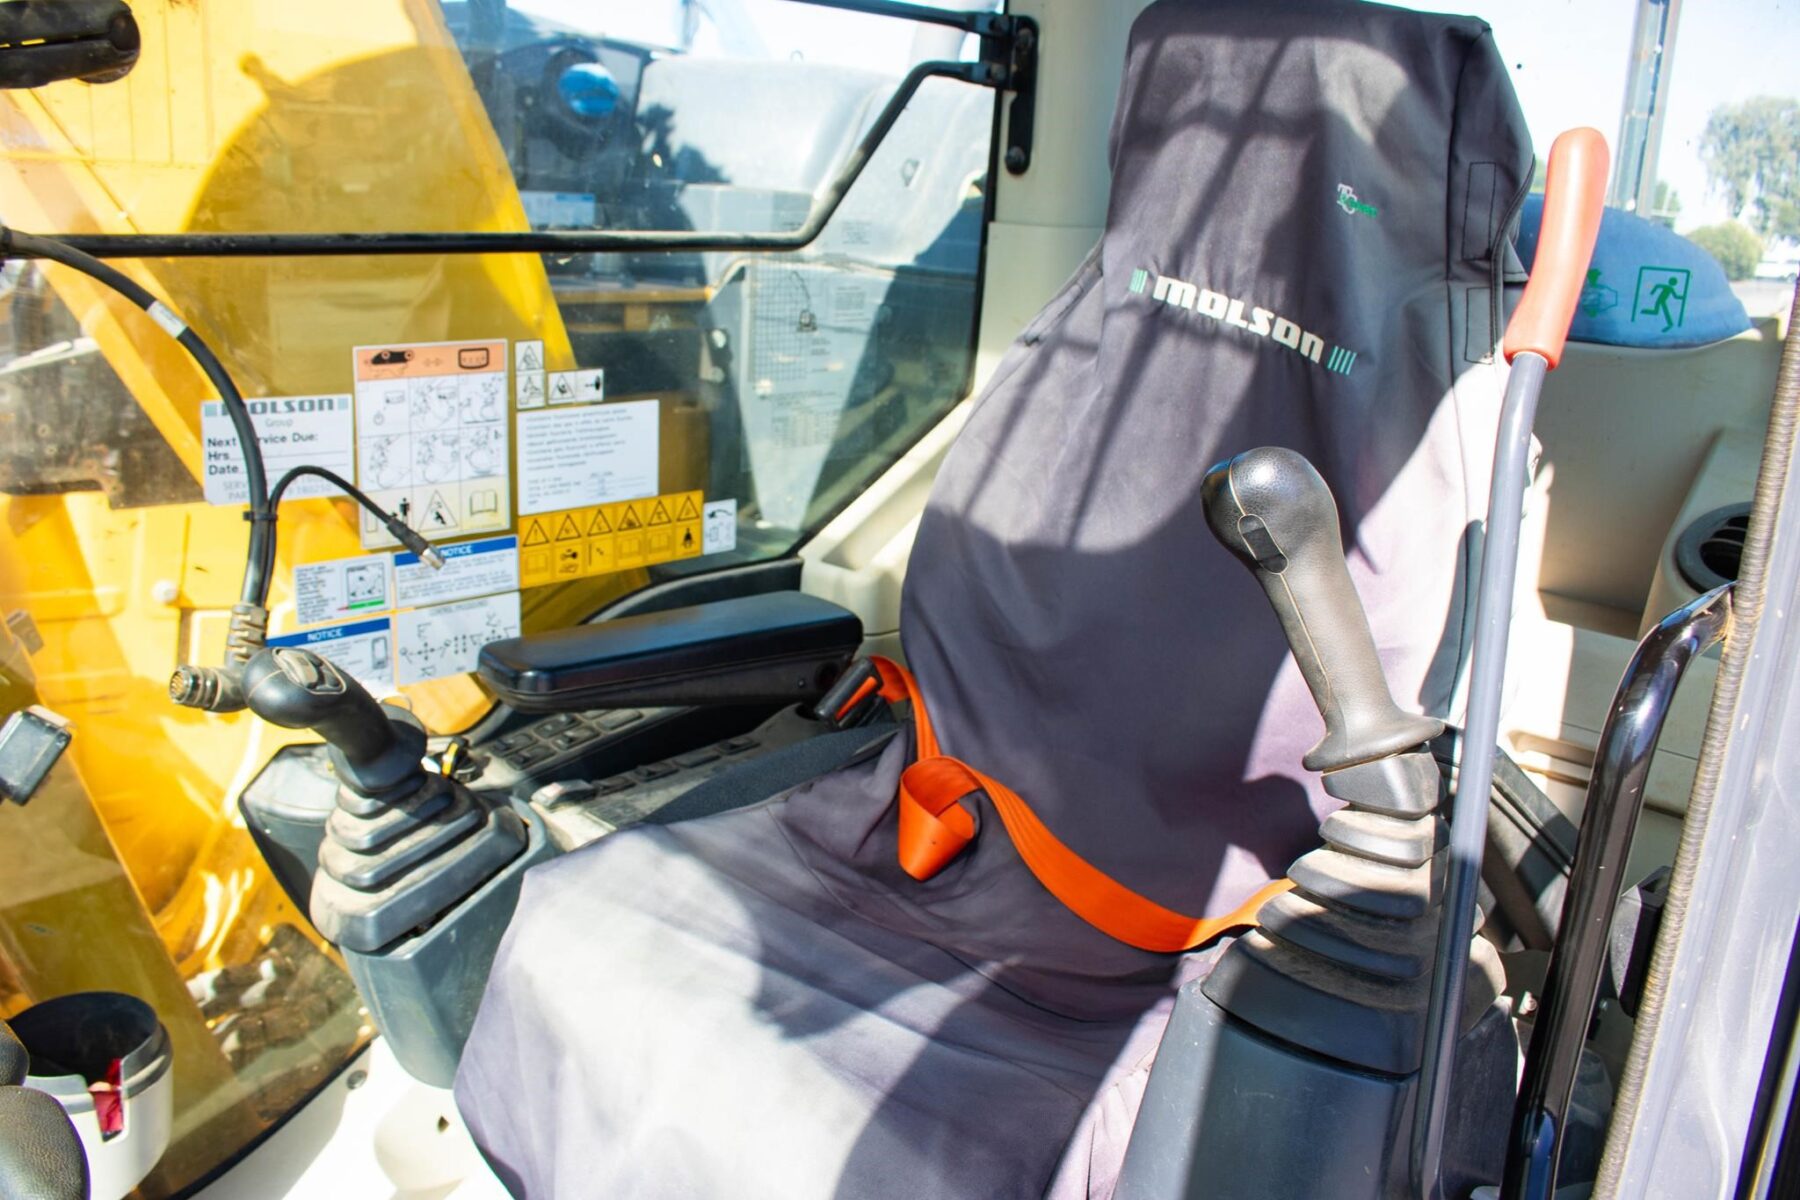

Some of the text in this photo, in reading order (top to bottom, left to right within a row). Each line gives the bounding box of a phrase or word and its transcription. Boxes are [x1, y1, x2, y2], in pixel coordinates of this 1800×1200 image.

[207, 437, 237, 448] Next
[256, 432, 287, 445] rvice
[207, 451, 230, 462] Hrs
[208, 464, 239, 476] Date
[307, 628, 343, 641] NOTICE
